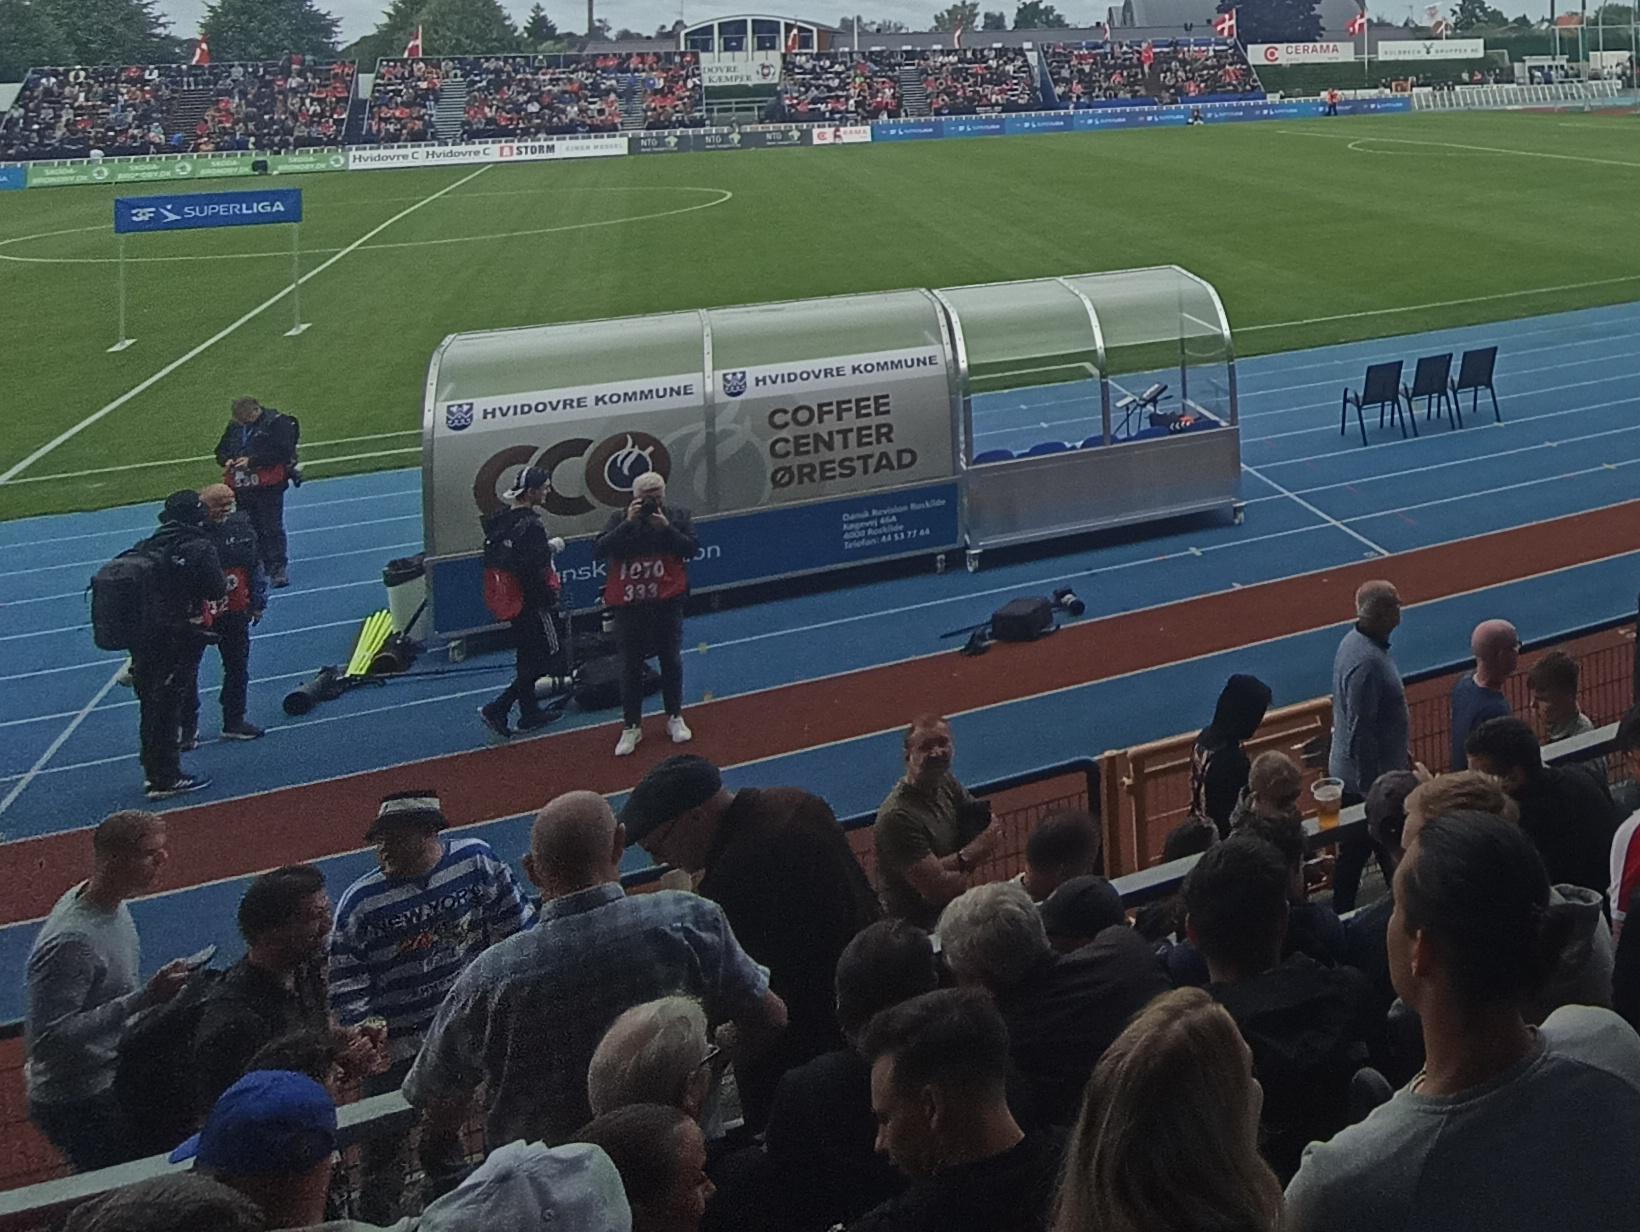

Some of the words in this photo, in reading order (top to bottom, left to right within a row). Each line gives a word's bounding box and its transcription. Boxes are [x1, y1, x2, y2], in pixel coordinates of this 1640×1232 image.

[1286, 44, 1339, 55] CERAMA
[352, 150, 409, 164] Hvidovre
[425, 147, 481, 161] Hvidovre
[516, 144, 555, 156] STORM
[183, 201, 285, 219] SUPERLIGA
[755, 365, 846, 387] HVIDOVRE
[851, 355, 939, 376] KOMMUNE
[482, 397, 588, 420] HVIDOVRE
[595, 384, 694, 406] KOMMUNE
[767, 394, 892, 430] COFFEE
[769, 423, 894, 460] CENTER
[770, 447, 918, 490] ØRESTAD
